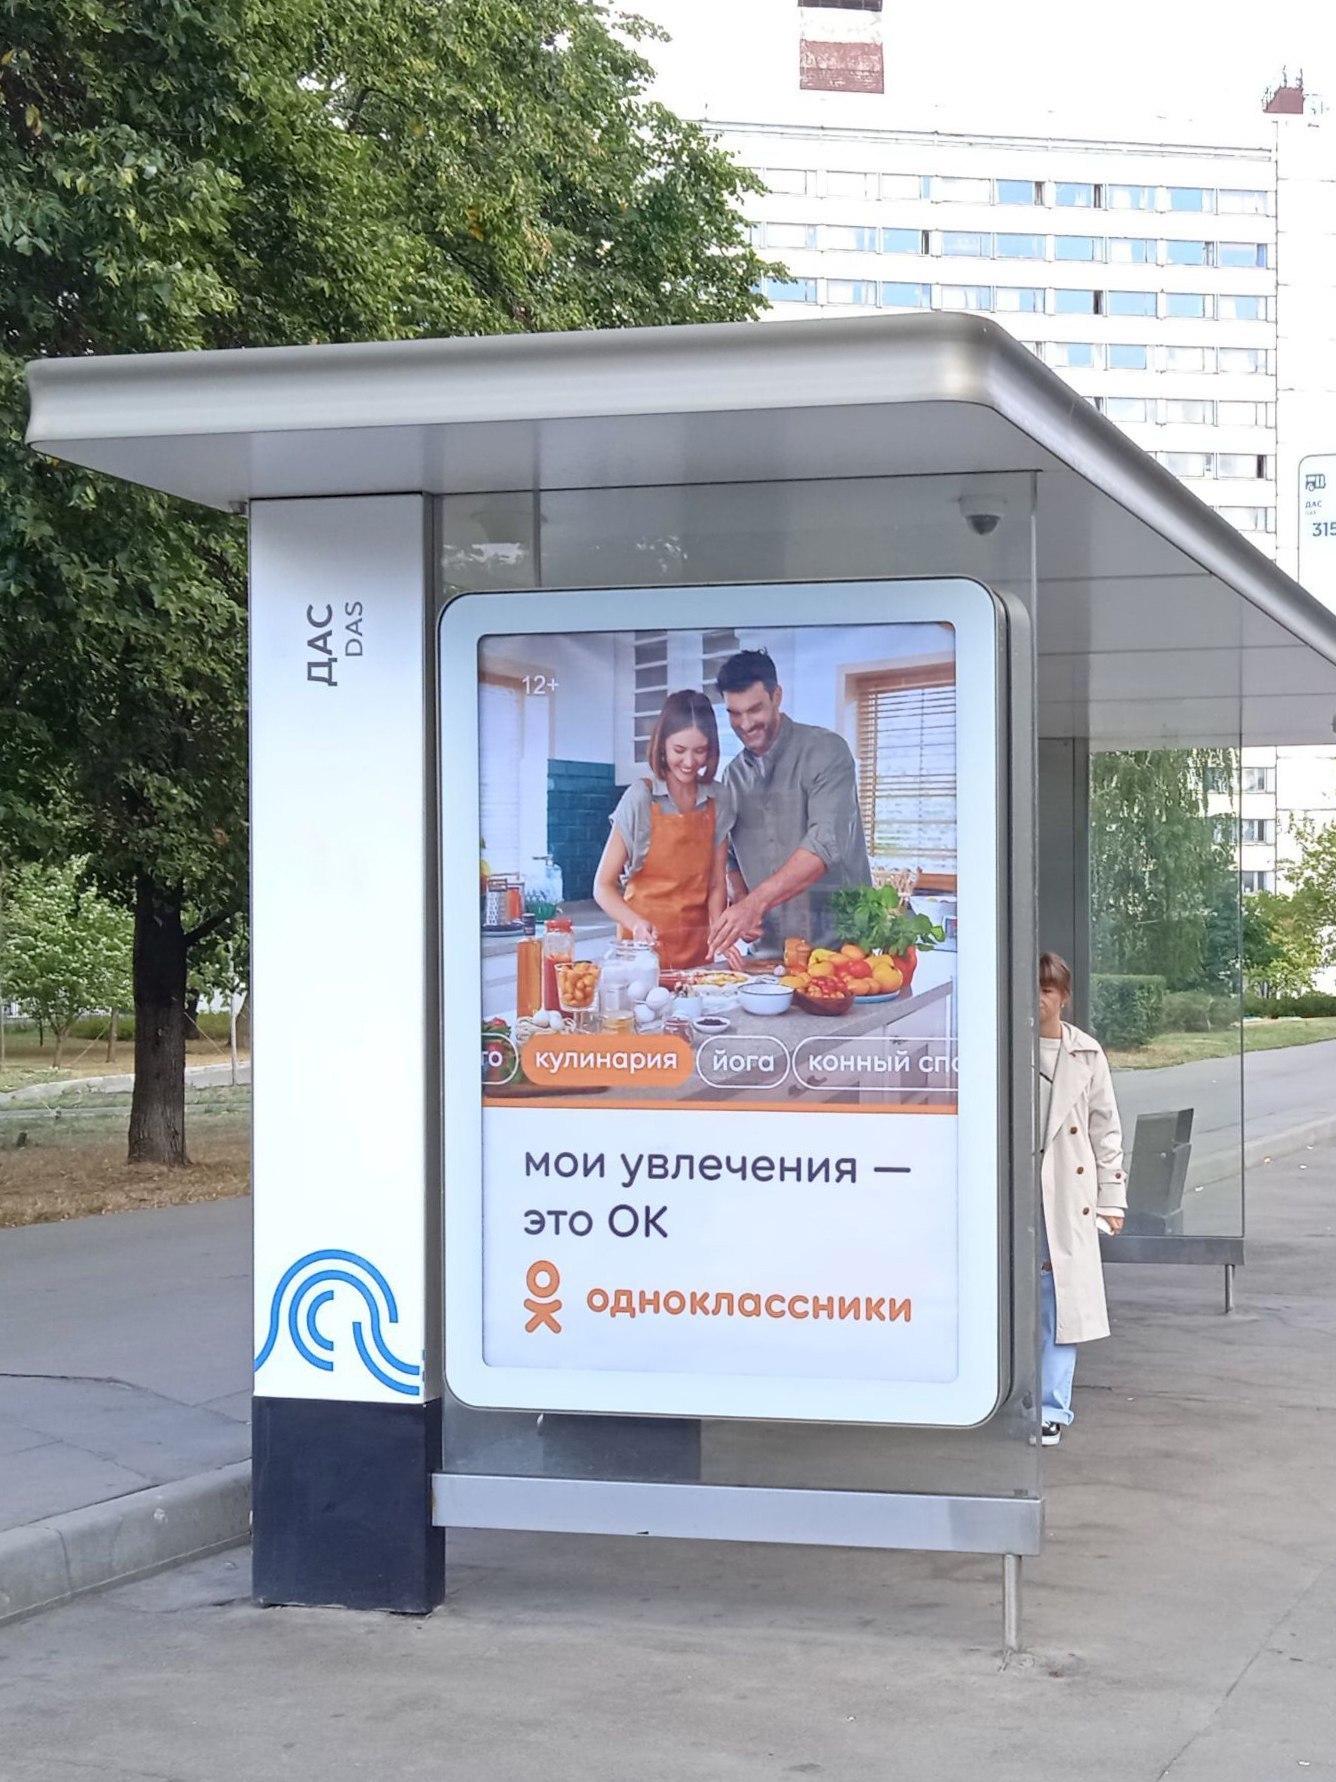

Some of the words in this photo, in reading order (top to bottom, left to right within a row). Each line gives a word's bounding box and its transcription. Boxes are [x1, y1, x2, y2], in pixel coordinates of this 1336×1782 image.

[306, 603, 338, 687] ДАС
[344, 601, 363, 657] DAS
[522, 675, 559, 695] 12+
[535, 1051, 678, 1075] кулинария
[713, 1049, 775, 1073] йога
[808, 1049, 910, 1073] конный
[525, 1151, 605, 1178] мои
[620, 1153, 857, 1188] увлечения
[523, 1209, 594, 1237] это
[607, 1203, 668, 1239] ОК
[586, 1287, 912, 1323] одноклассники
